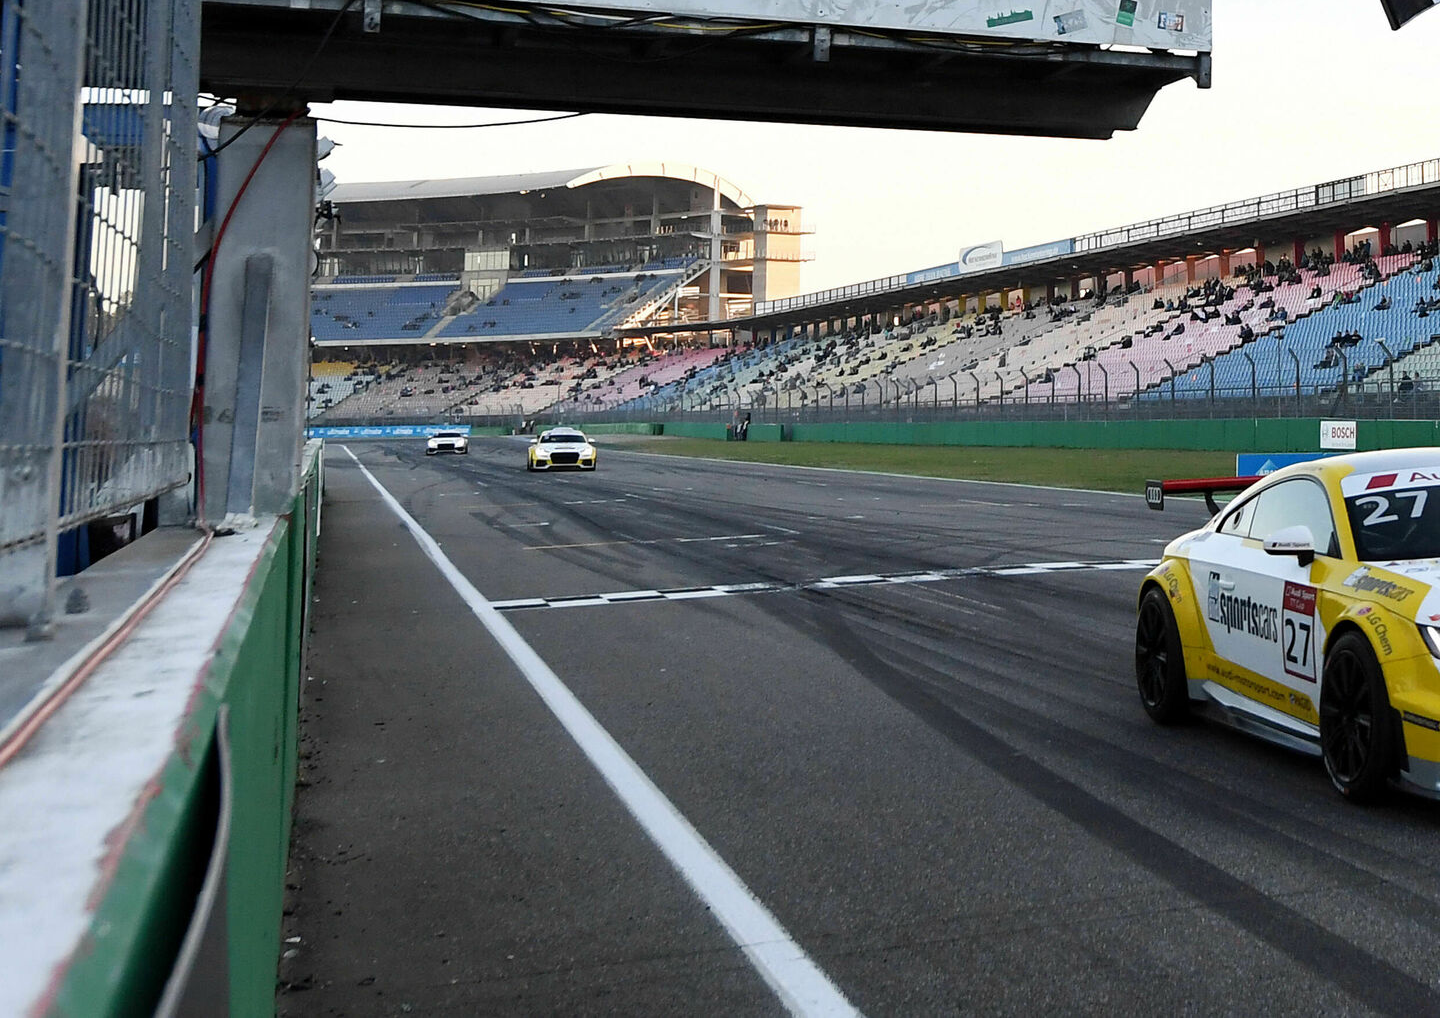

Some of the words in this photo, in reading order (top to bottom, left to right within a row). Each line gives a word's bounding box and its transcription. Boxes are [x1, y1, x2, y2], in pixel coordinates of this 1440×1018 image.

[1331, 427, 1355, 438] BOSCH
[1355, 490, 1428, 526] 27
[1219, 592, 1278, 643] sportscars
[1366, 612, 1381, 625] LG
[1374, 624, 1393, 656] Chem
[1285, 618, 1310, 666] 27
